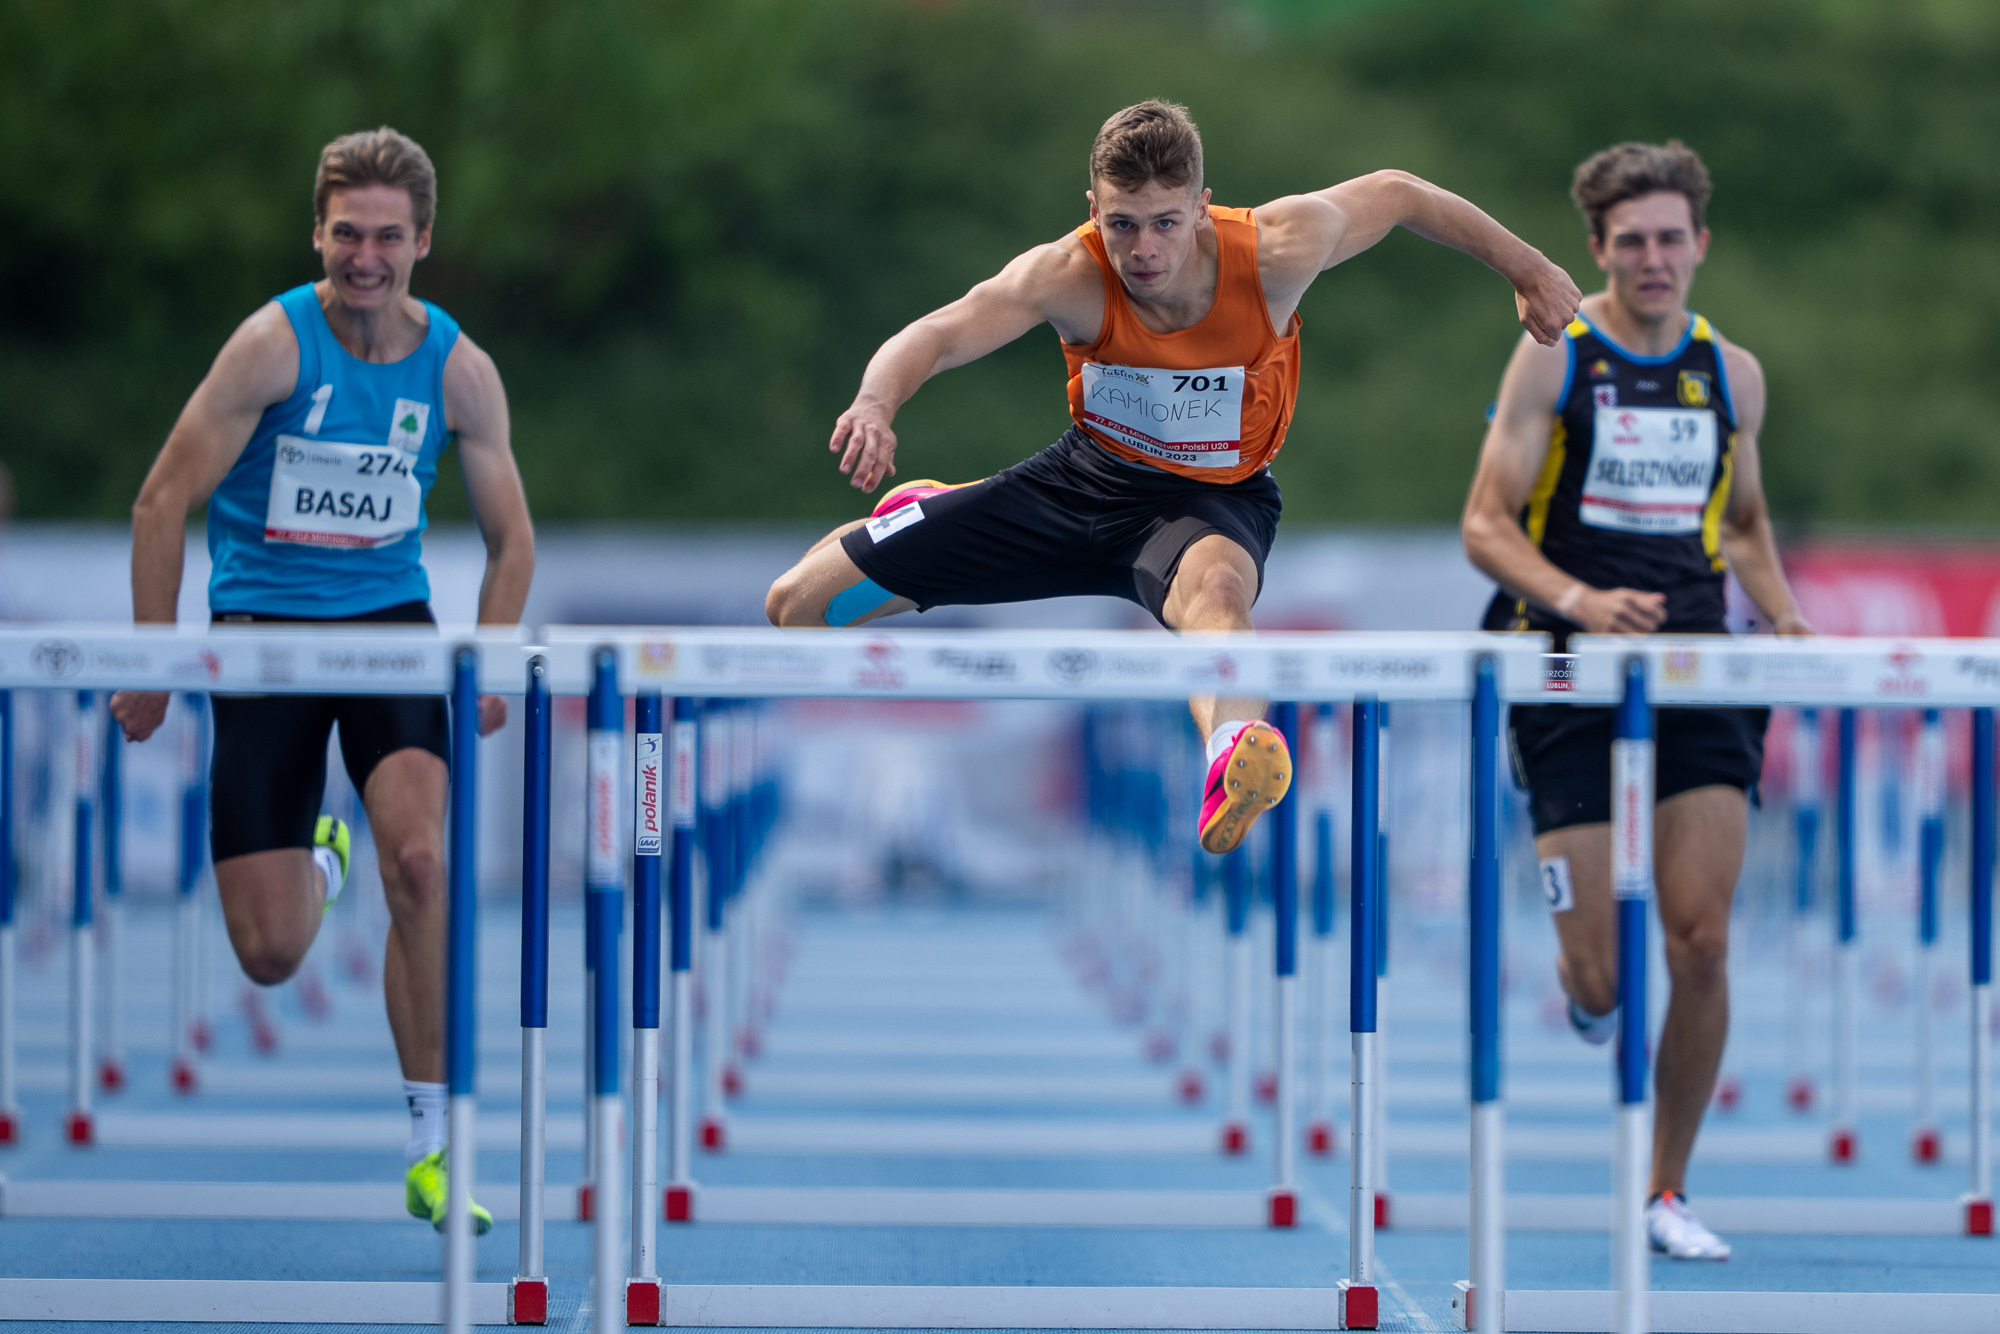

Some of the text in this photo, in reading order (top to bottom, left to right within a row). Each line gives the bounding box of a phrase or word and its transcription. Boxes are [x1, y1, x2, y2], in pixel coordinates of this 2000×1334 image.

[1172, 375, 1228, 393] 701
[1091, 385, 1222, 422] KAMIONEK
[1108, 421, 1128, 434] PZLA
[1129, 429, 1181, 451] Mistrzostwa
[1182, 443, 1209, 451] Polski
[1211, 442, 1229, 451] U20
[1669, 417, 1699, 442] 59
[1122, 436, 1197, 462] LUBLIN 2023
[357, 452, 409, 477] 274
[295, 487, 392, 522] BASAJ
[642, 764, 658, 832] polanik
[640, 839, 659, 847] IAAF
